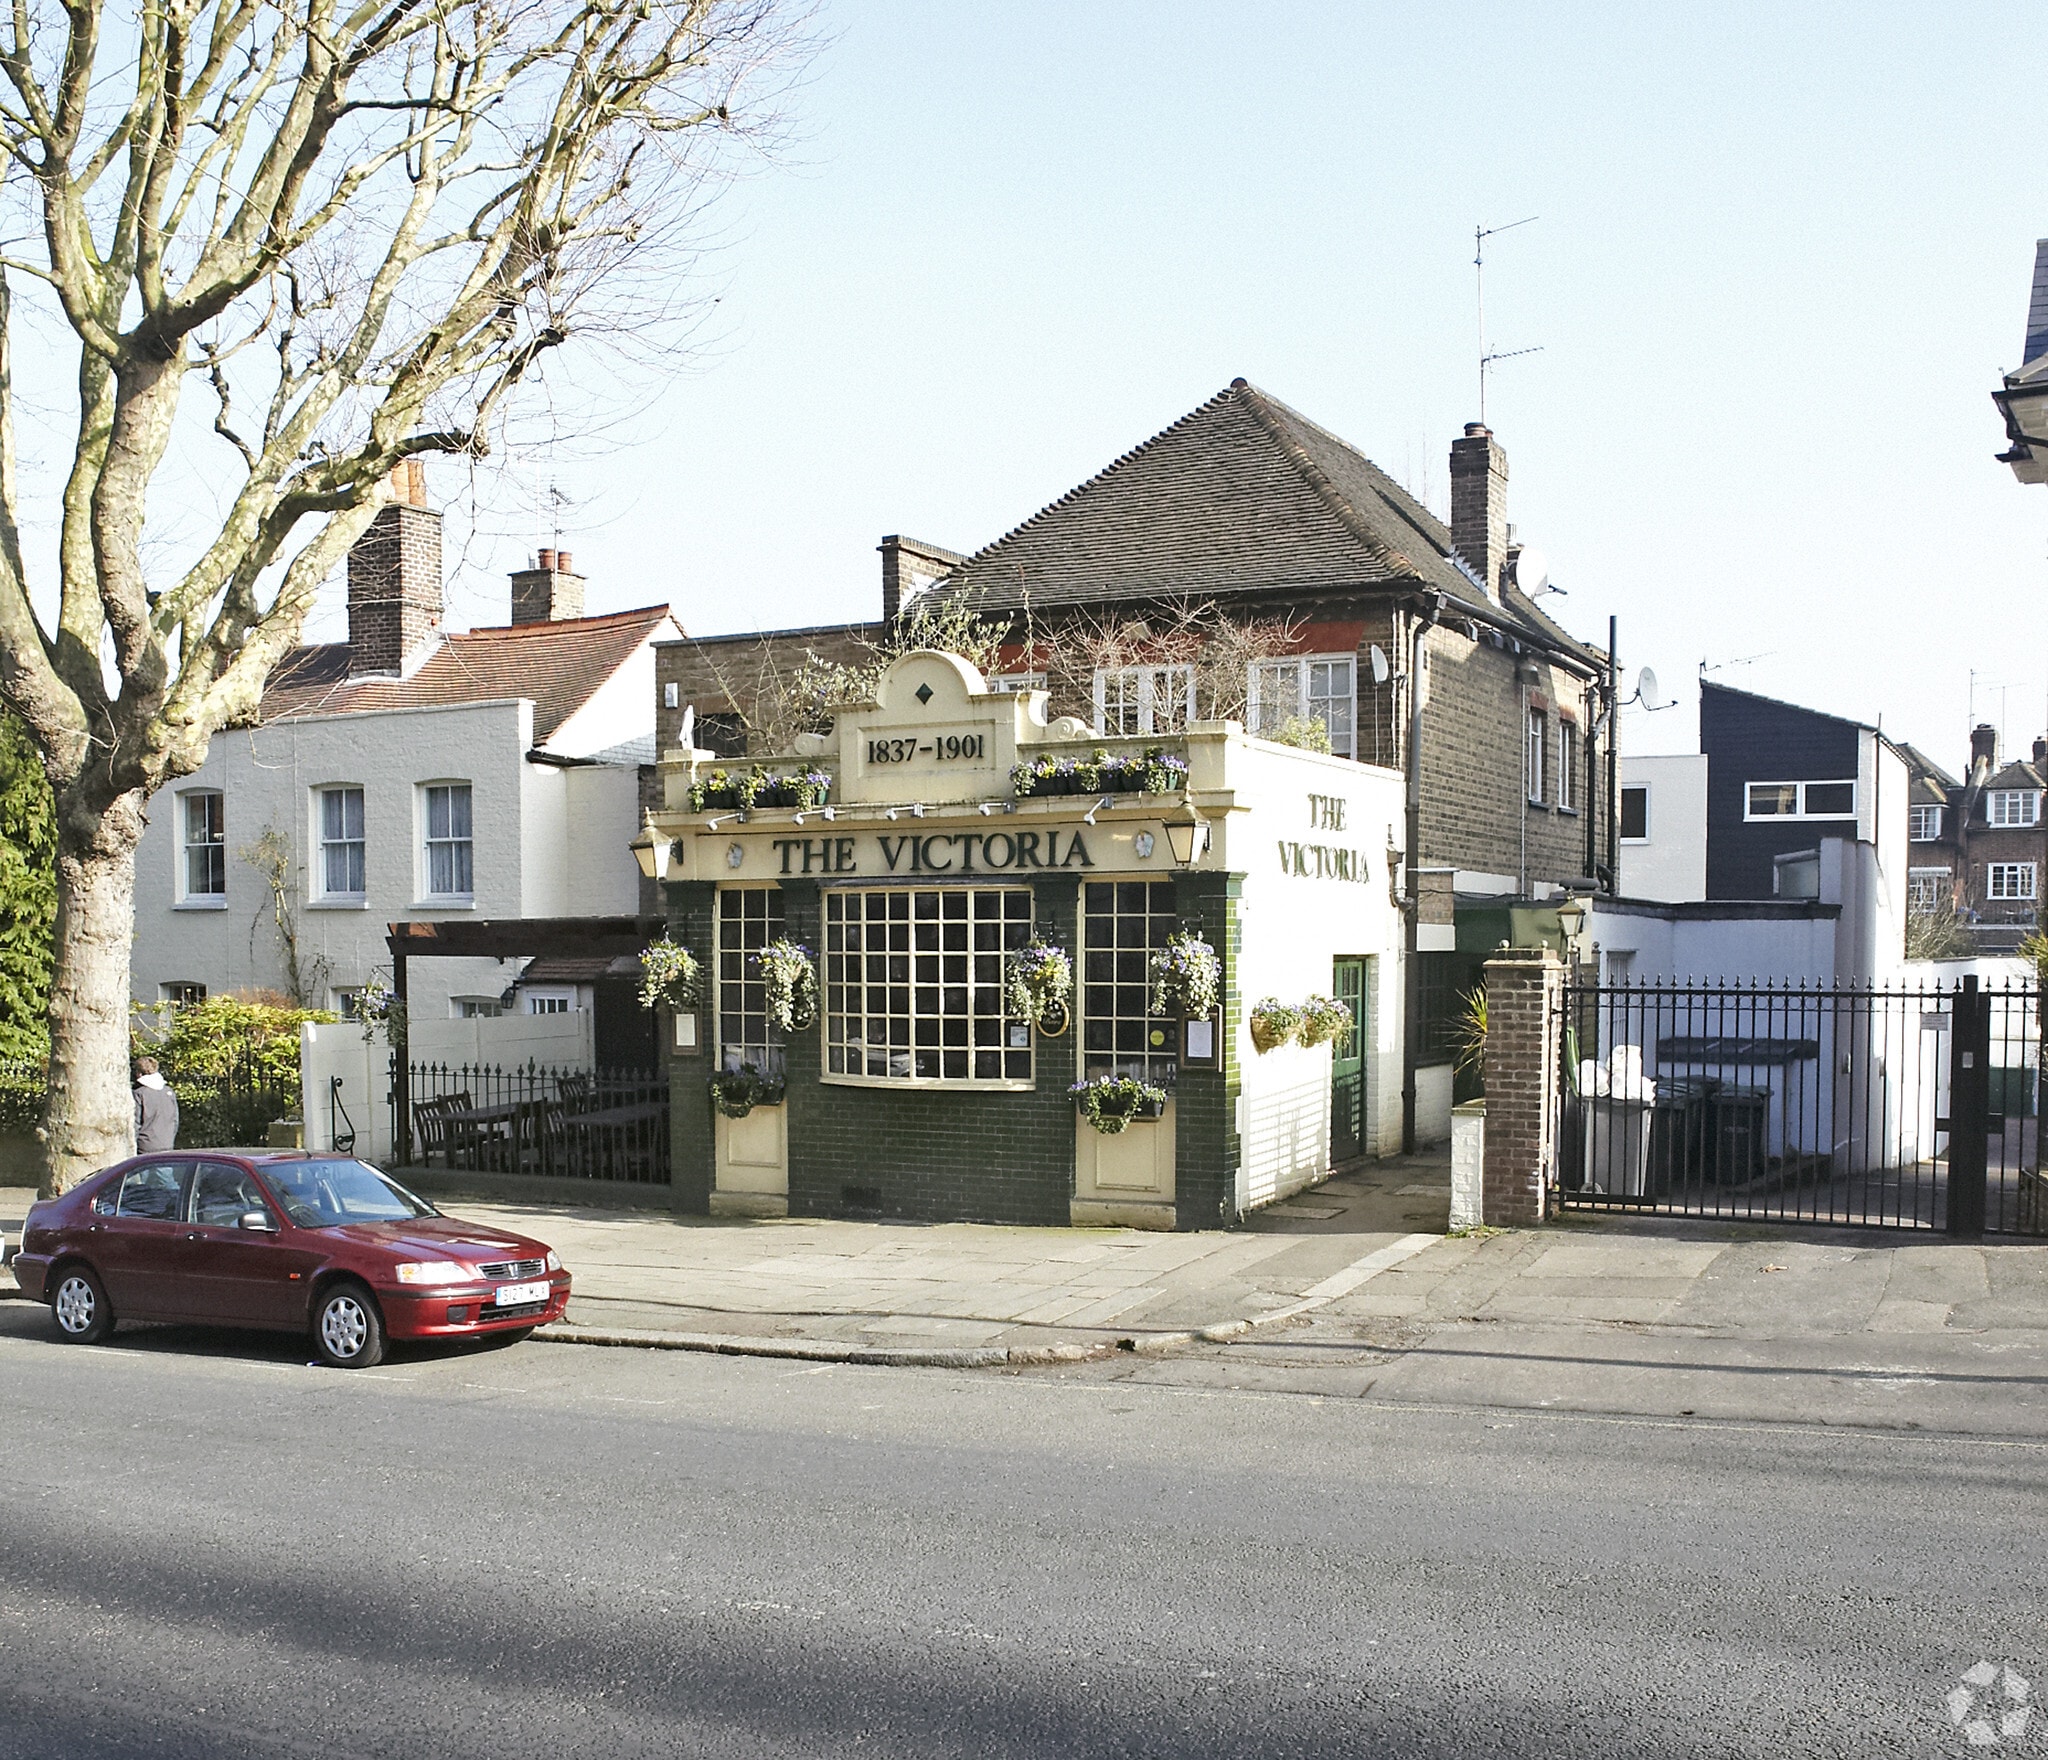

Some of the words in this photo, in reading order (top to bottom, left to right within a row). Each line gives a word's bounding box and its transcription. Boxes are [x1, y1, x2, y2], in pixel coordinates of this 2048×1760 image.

[867, 734, 984, 764] 1837-1901
[1307, 793, 1347, 832] THE
[772, 836, 857, 874] THE
[876, 829, 1096, 872] VICTORIA
[1277, 840, 1370, 884] VICTORIA
